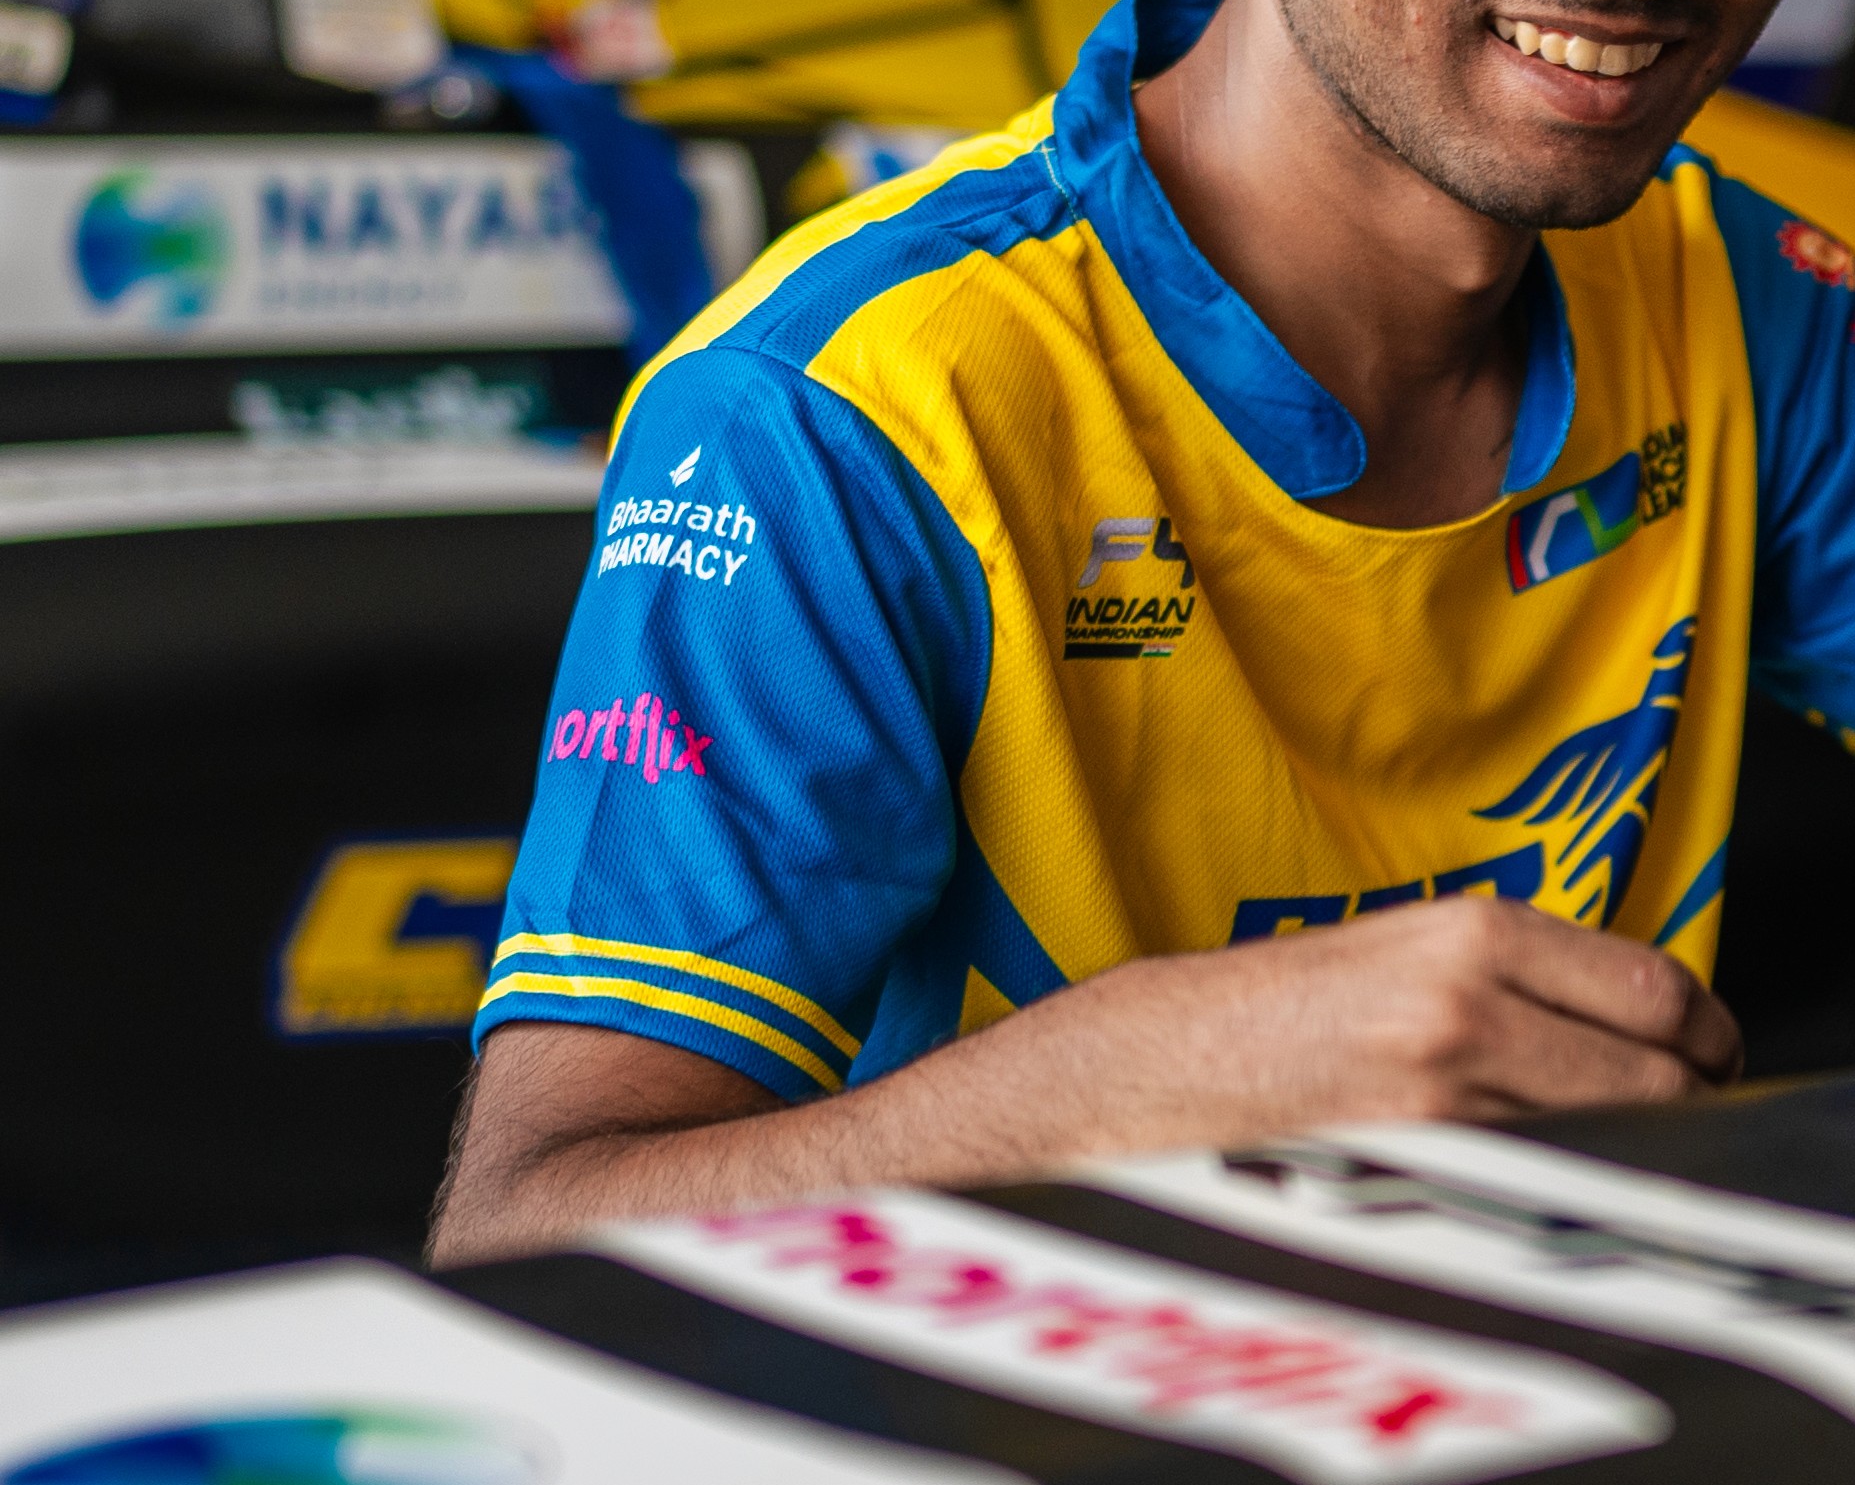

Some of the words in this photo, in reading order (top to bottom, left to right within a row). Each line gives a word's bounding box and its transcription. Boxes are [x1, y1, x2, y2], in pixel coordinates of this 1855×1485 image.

[258, 171, 596, 256] NAYAR
[607, 496, 756, 545] Bhaarath
[598, 531, 748, 586] PHARMACY
[1077, 517, 1195, 590] F4
[1066, 596, 1195, 624] INDIAN
[548, 691, 713, 784] ortflix
